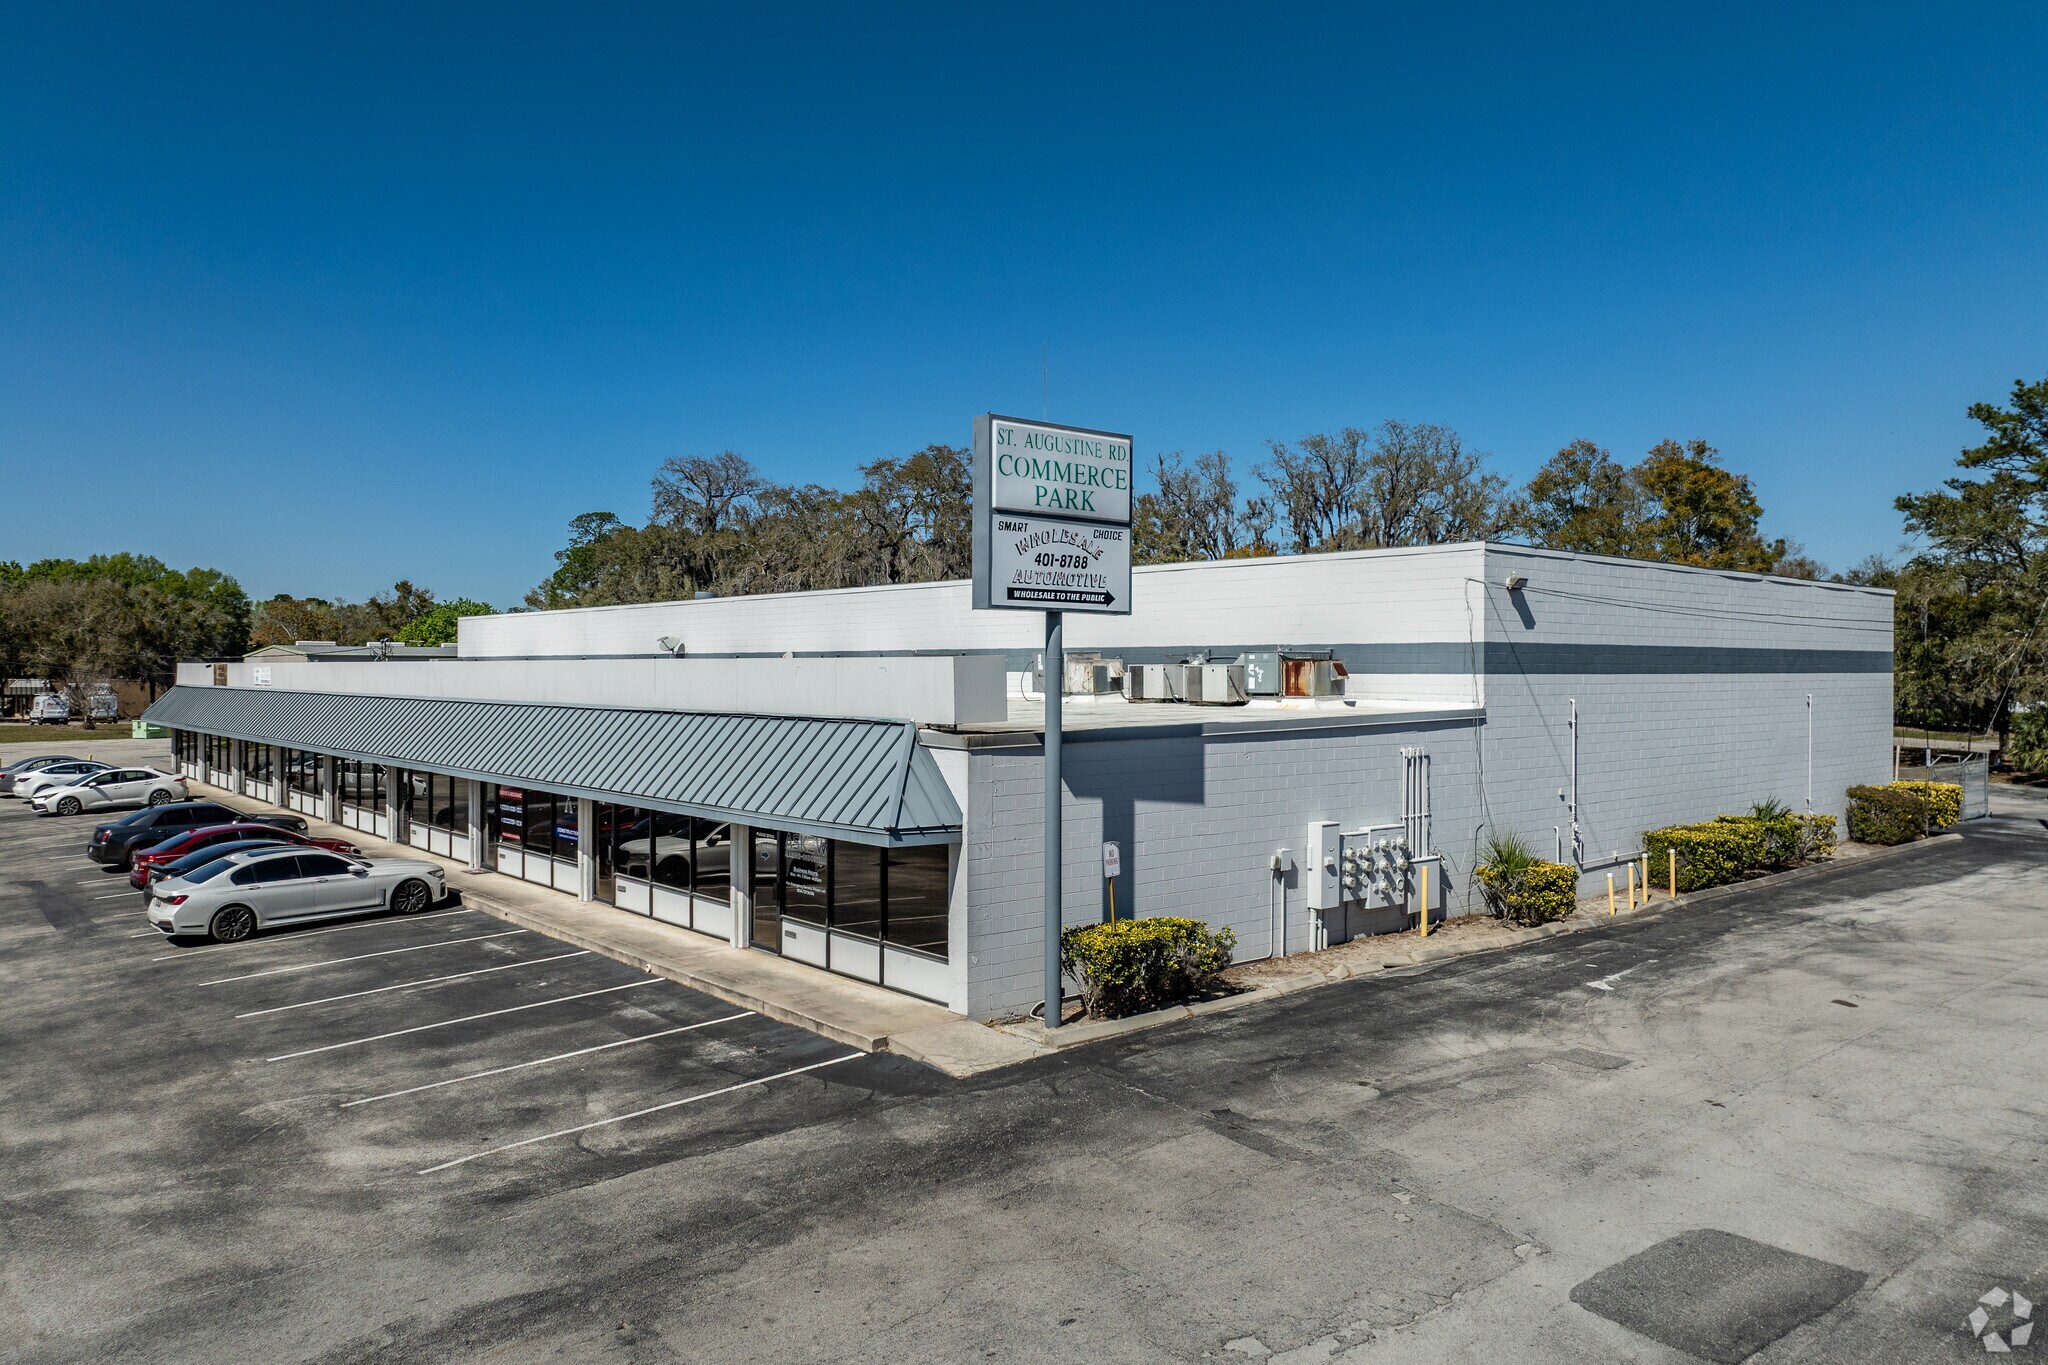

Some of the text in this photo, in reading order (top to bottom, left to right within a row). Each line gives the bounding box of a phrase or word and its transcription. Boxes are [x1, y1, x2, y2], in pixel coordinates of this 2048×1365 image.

[997, 428, 1129, 462] ST. AUGUSTINE RD.
[998, 454, 1127, 490] COMMERCE
[1035, 485, 1095, 512] PARK
[998, 520, 1123, 541] SMART CHOICE
[1015, 528, 1104, 560] WHOLESALE
[1034, 552, 1088, 569] 401-8788
[1012, 569, 1107, 589] AUTOMOTIVE
[1013, 590, 1105, 602] WHOLESALE TO THE PUBLIC
